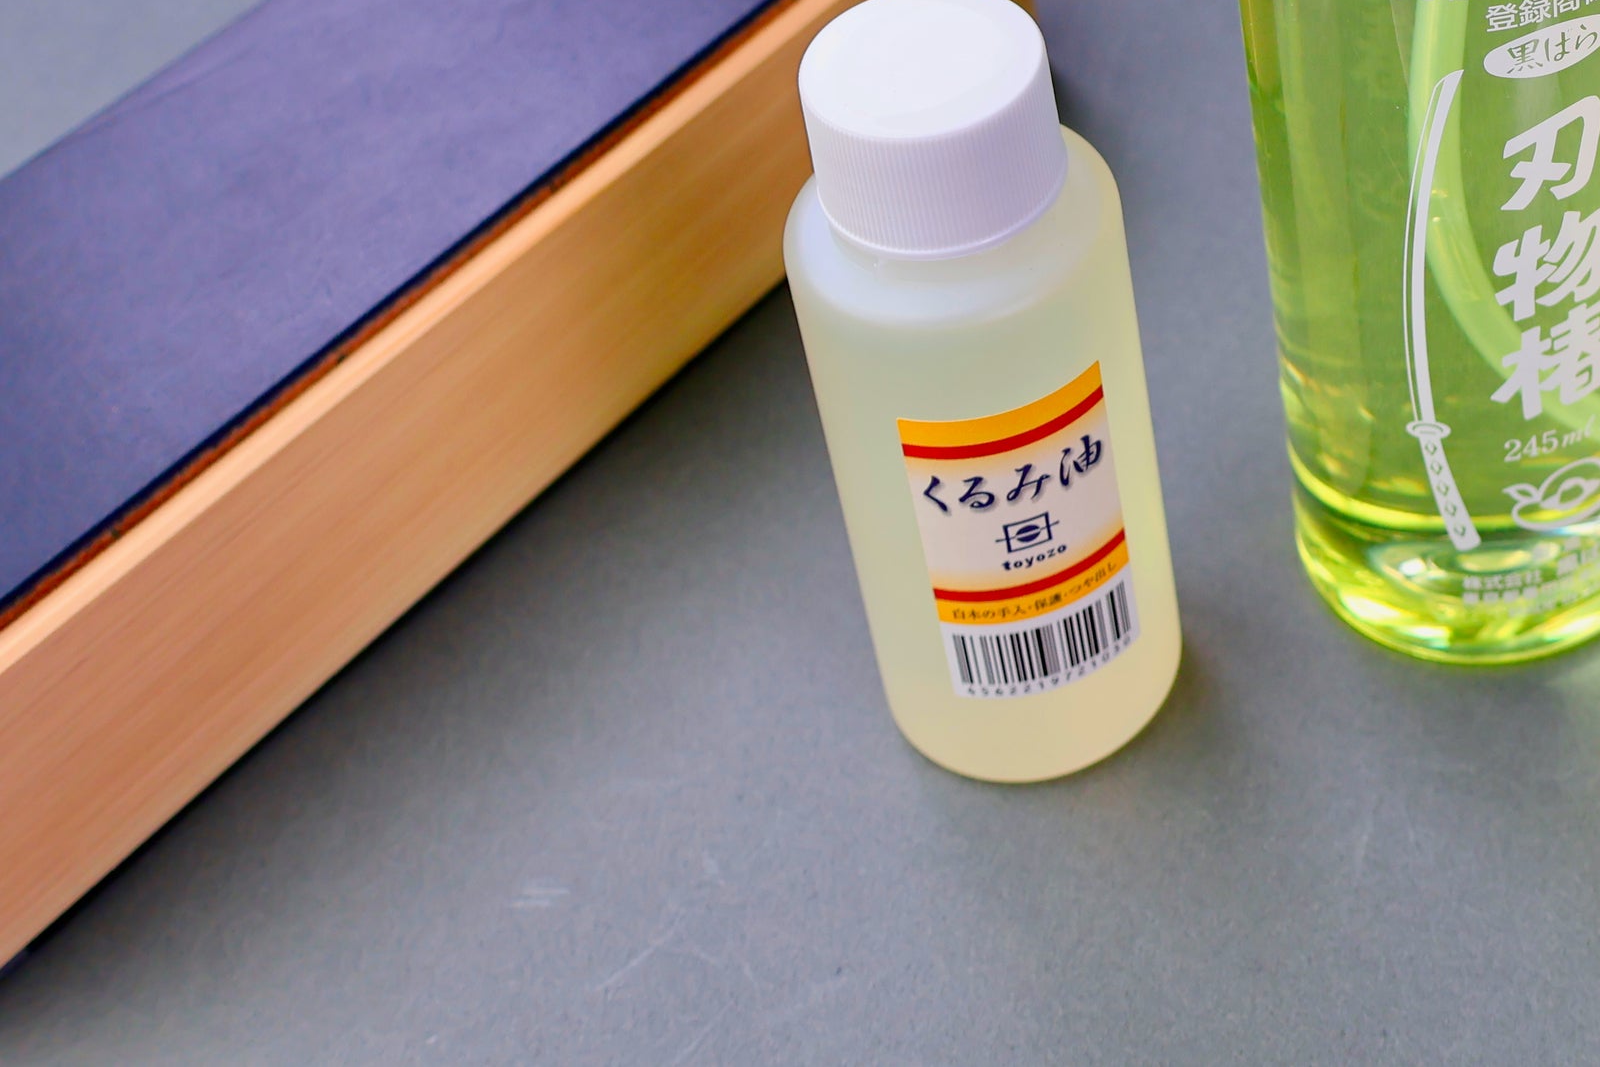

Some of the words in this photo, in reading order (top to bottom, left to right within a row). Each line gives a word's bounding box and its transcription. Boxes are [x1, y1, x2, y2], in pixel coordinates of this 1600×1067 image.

[922, 434, 1103, 514] くるみ油
[1001, 544, 1068, 571] toyozo
